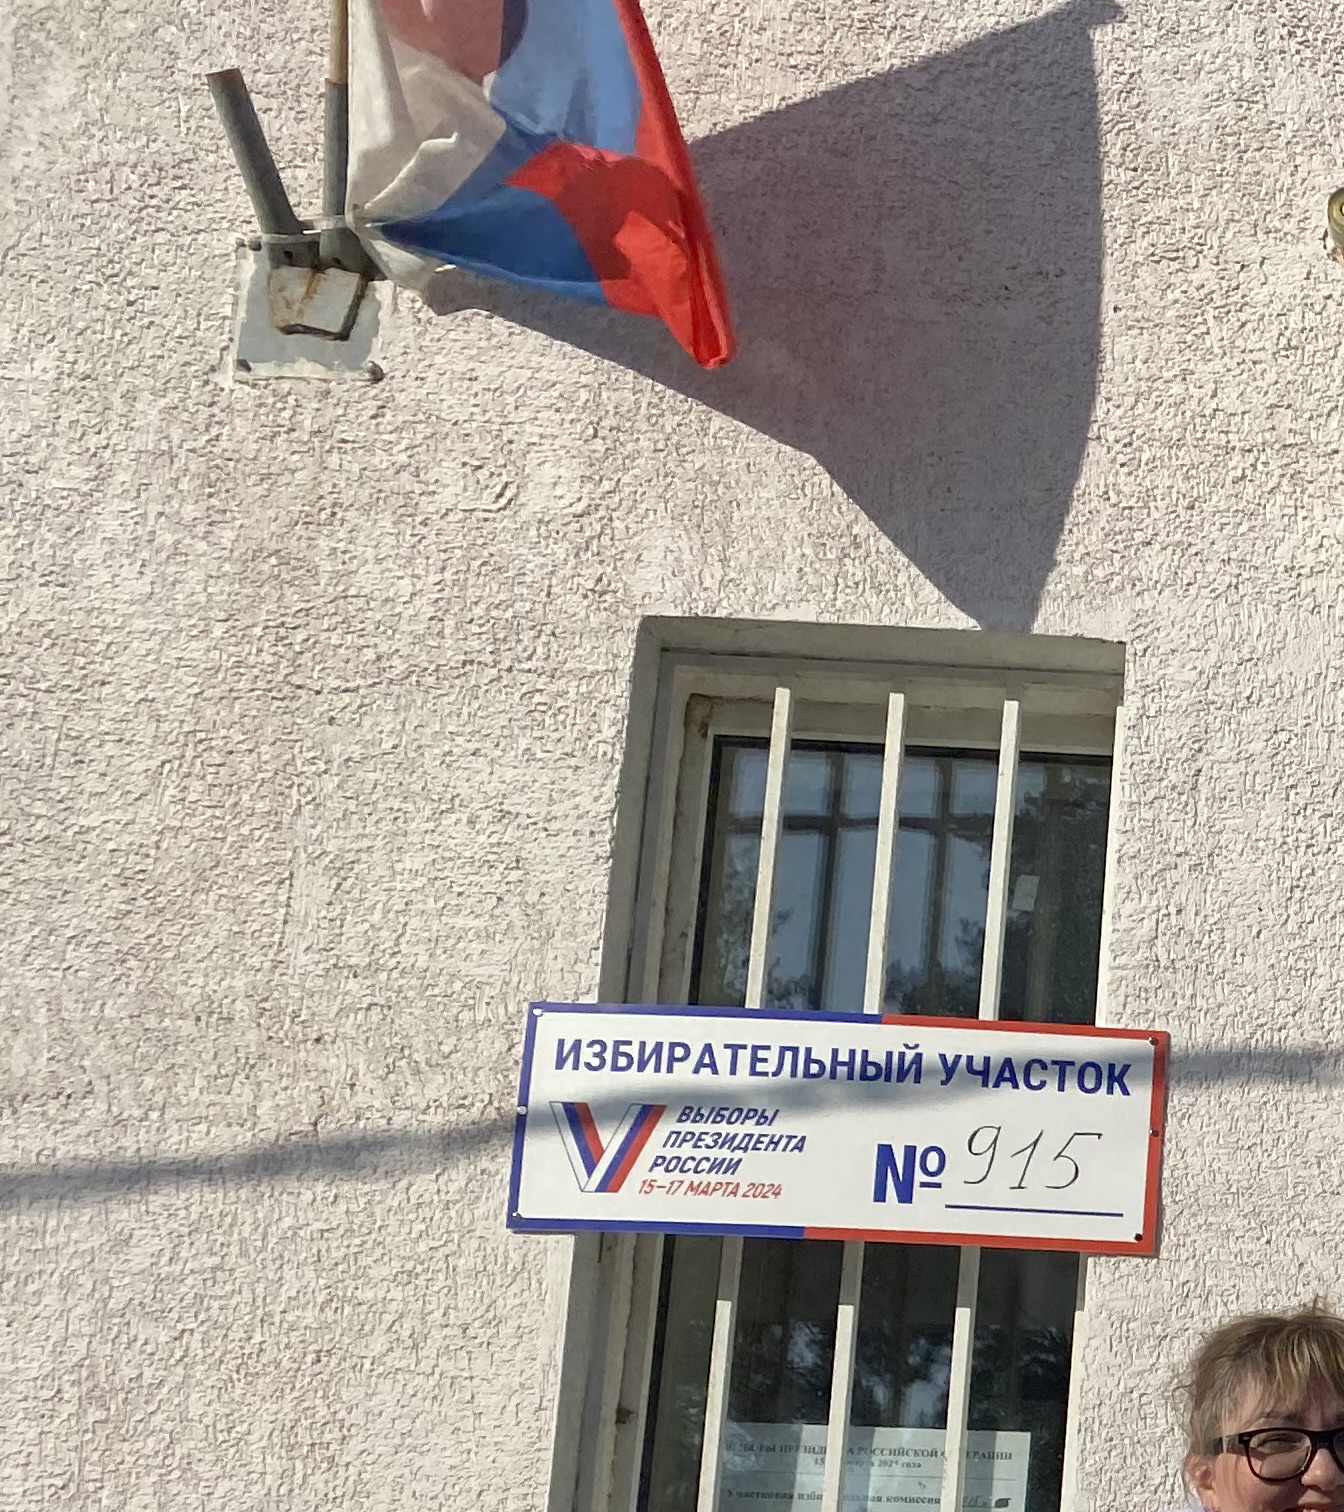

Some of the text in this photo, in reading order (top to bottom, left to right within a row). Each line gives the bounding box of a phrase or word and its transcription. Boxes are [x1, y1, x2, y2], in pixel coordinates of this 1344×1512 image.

[554, 1037, 1132, 1097] ИЗБИРАТЕЛЬНЫЙ УЧАСТОК
[676, 1106, 780, 1127] ВЫБОРЫ
[662, 1130, 807, 1153] ПРЕЗИДЕНТА
[648, 1155, 743, 1176] РОССИИ
[873, 1124, 1103, 1205] № 915
[685, 1180, 738, 1198] МАРТА
[741, 1183, 783, 1199] 2024
